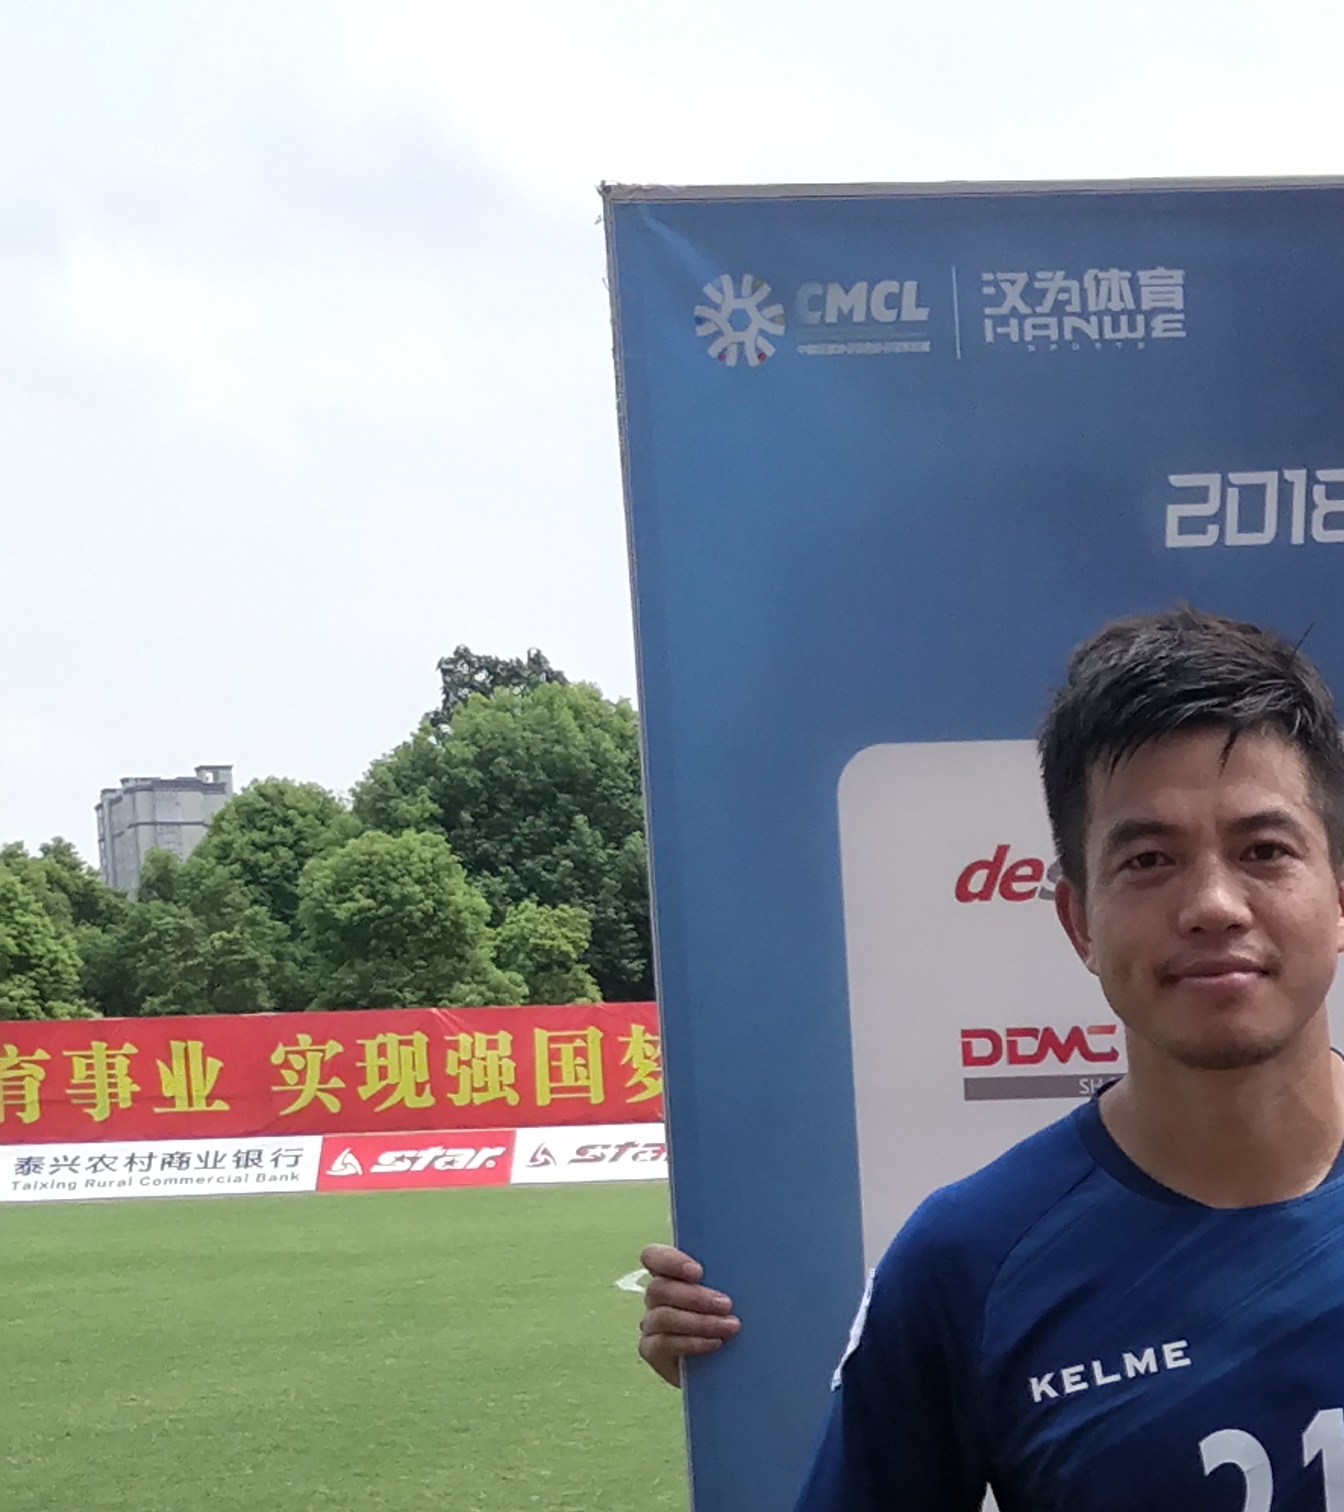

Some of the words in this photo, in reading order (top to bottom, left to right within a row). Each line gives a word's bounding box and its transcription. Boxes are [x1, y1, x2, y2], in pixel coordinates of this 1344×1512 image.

[796, 280, 930, 324] CMCL
[981, 267, 1187, 315] 汉为体育
[984, 313, 1187, 343] HANWE
[960, 1025, 1120, 1067] DDMC
[14, 1148, 304, 1177] 泰兴农村商业银行
[567, 1140, 669, 1165] sta
[11, 1179, 77, 1192] Taixing
[85, 1176, 133, 1189] Rural
[139, 1173, 249, 1187] Commercial
[255, 1171, 301, 1183] Bank
[1027, 1340, 1192, 1403] KELME
